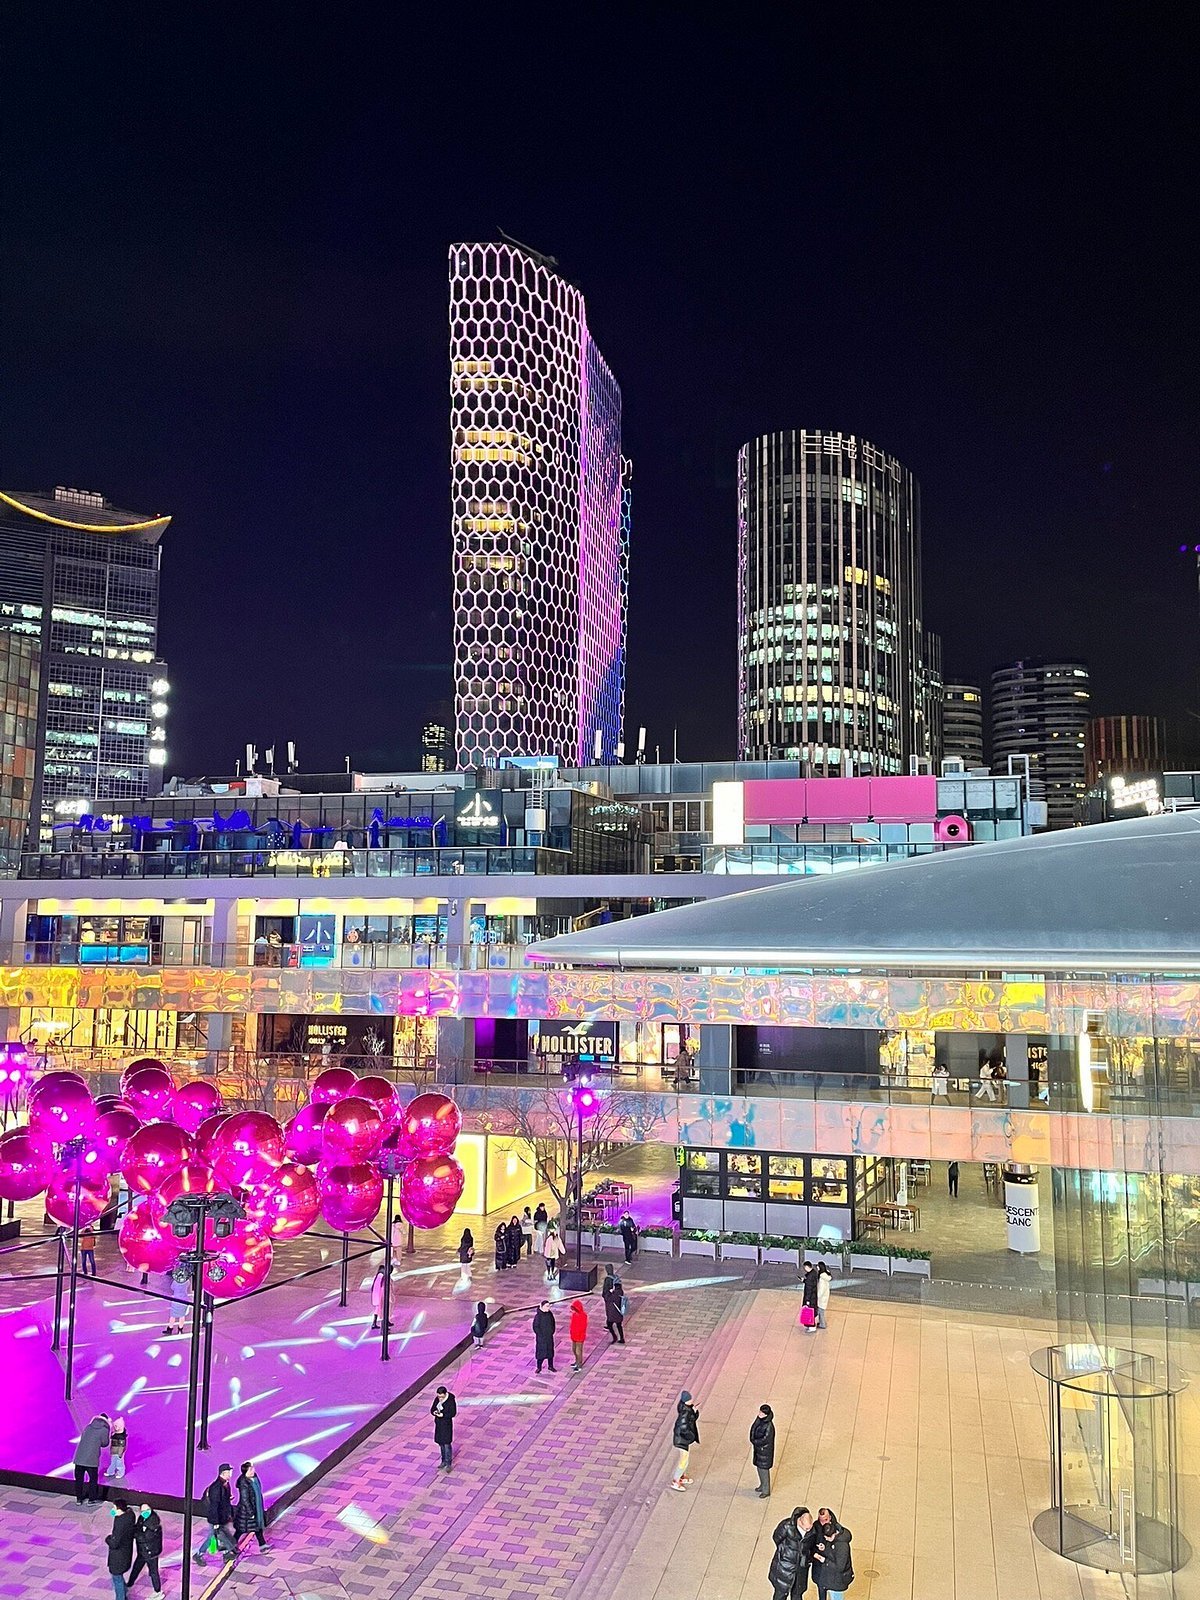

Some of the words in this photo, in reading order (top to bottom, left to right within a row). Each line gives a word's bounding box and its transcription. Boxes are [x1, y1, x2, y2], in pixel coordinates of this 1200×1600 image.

[803, 435, 857, 459] 三里屯
[862, 444, 901, 483] SOHO
[461, 792, 492, 816] 小
[304, 921, 331, 944] 小
[308, 1025, 347, 1036] HOLLISTER
[541, 1035, 612, 1054] HOLLISTER
